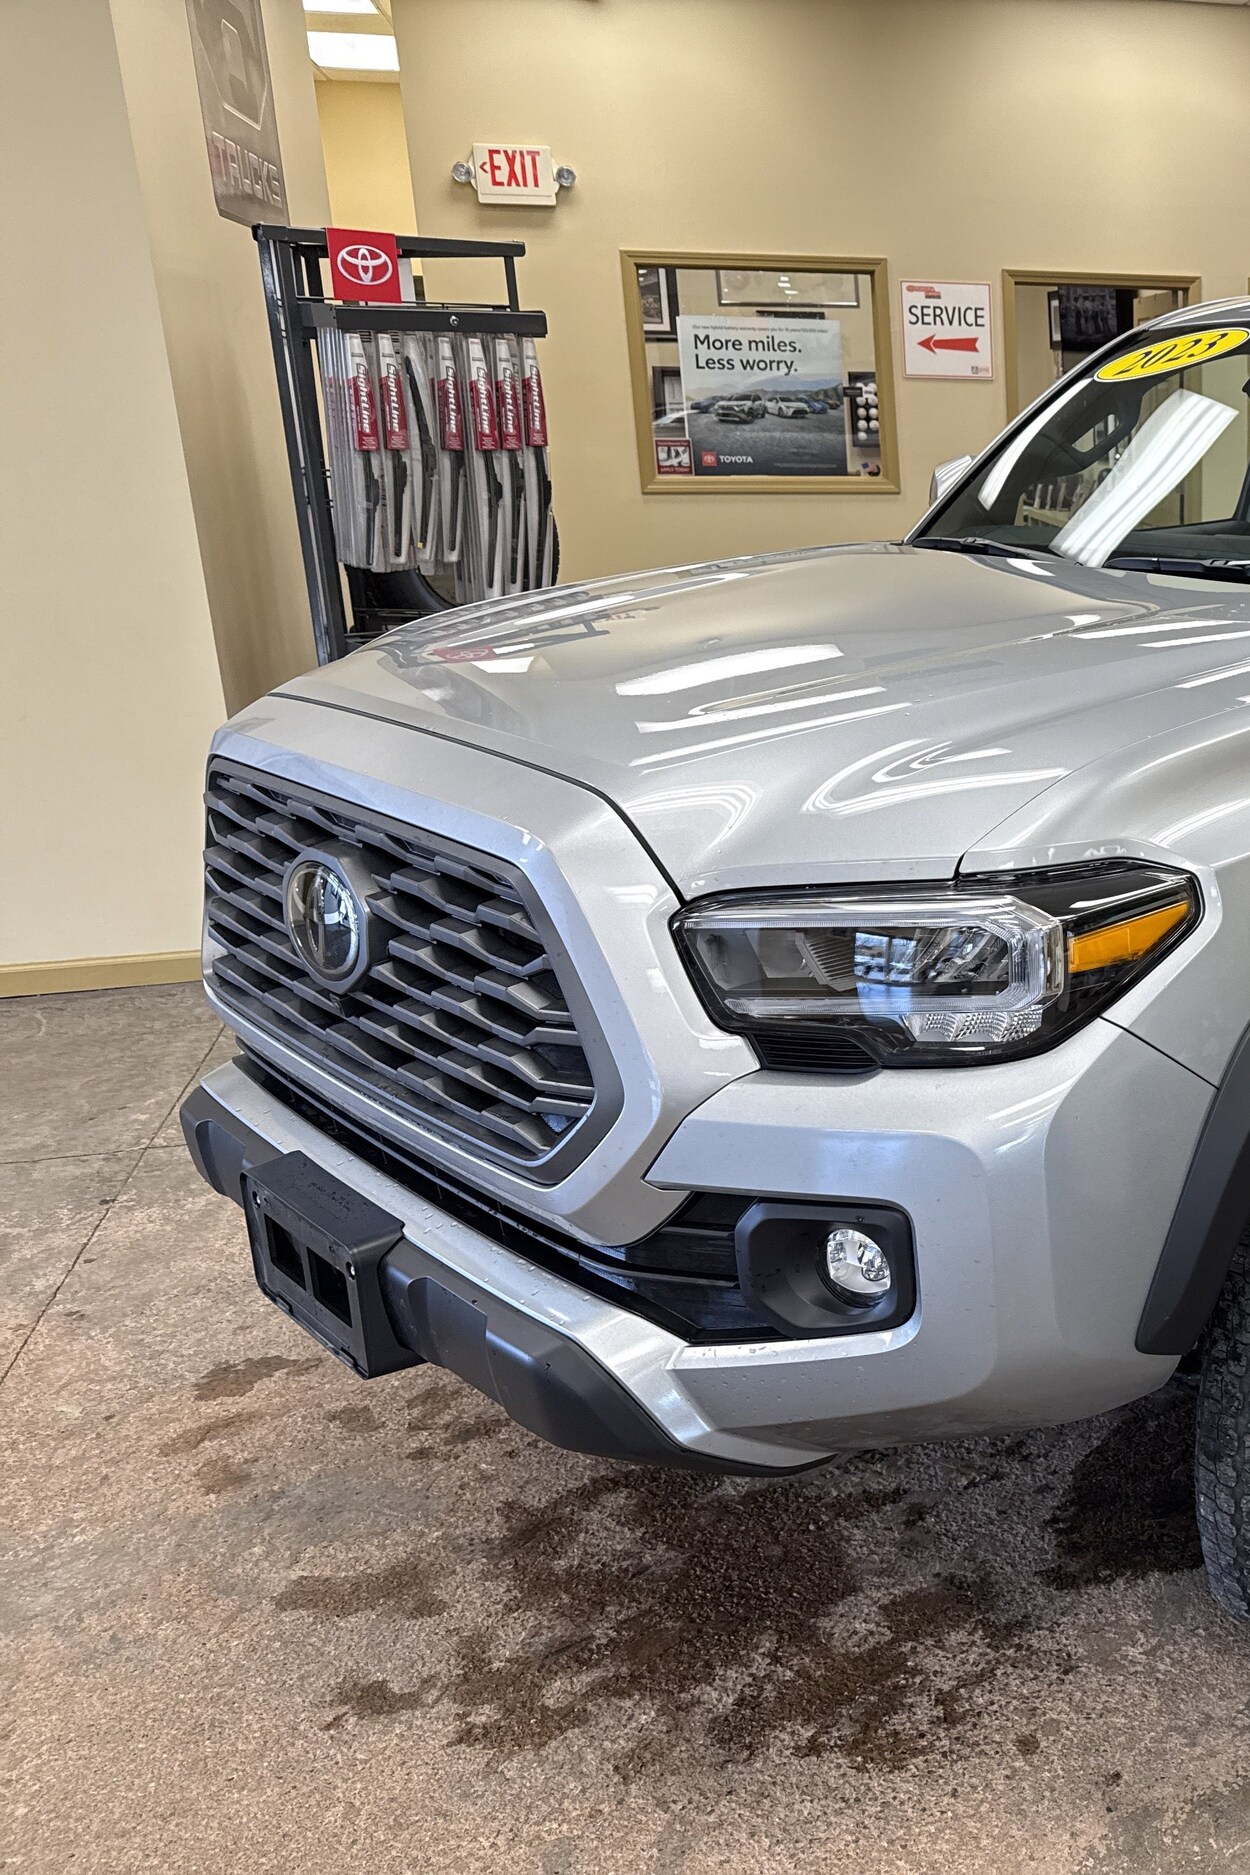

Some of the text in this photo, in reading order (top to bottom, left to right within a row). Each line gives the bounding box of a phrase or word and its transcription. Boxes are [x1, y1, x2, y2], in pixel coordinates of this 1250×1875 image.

[211, 131, 283, 209] TRUCKS
[488, 148, 541, 189] EXIT
[693, 333, 802, 353] More miles.
[908, 304, 985, 328] SERVICE
[695, 353, 798, 376] Less worry.
[1112, 332, 1229, 377] 2023
[356, 362, 370, 433] SightLine
[386, 362, 400, 433] SightLine
[446, 366, 457, 433] SightLine
[477, 367, 490, 434] SightLine
[503, 367, 514, 434] SightLine
[530, 365, 541, 430] SightLine
[719, 455, 753, 464] TOYOTA
